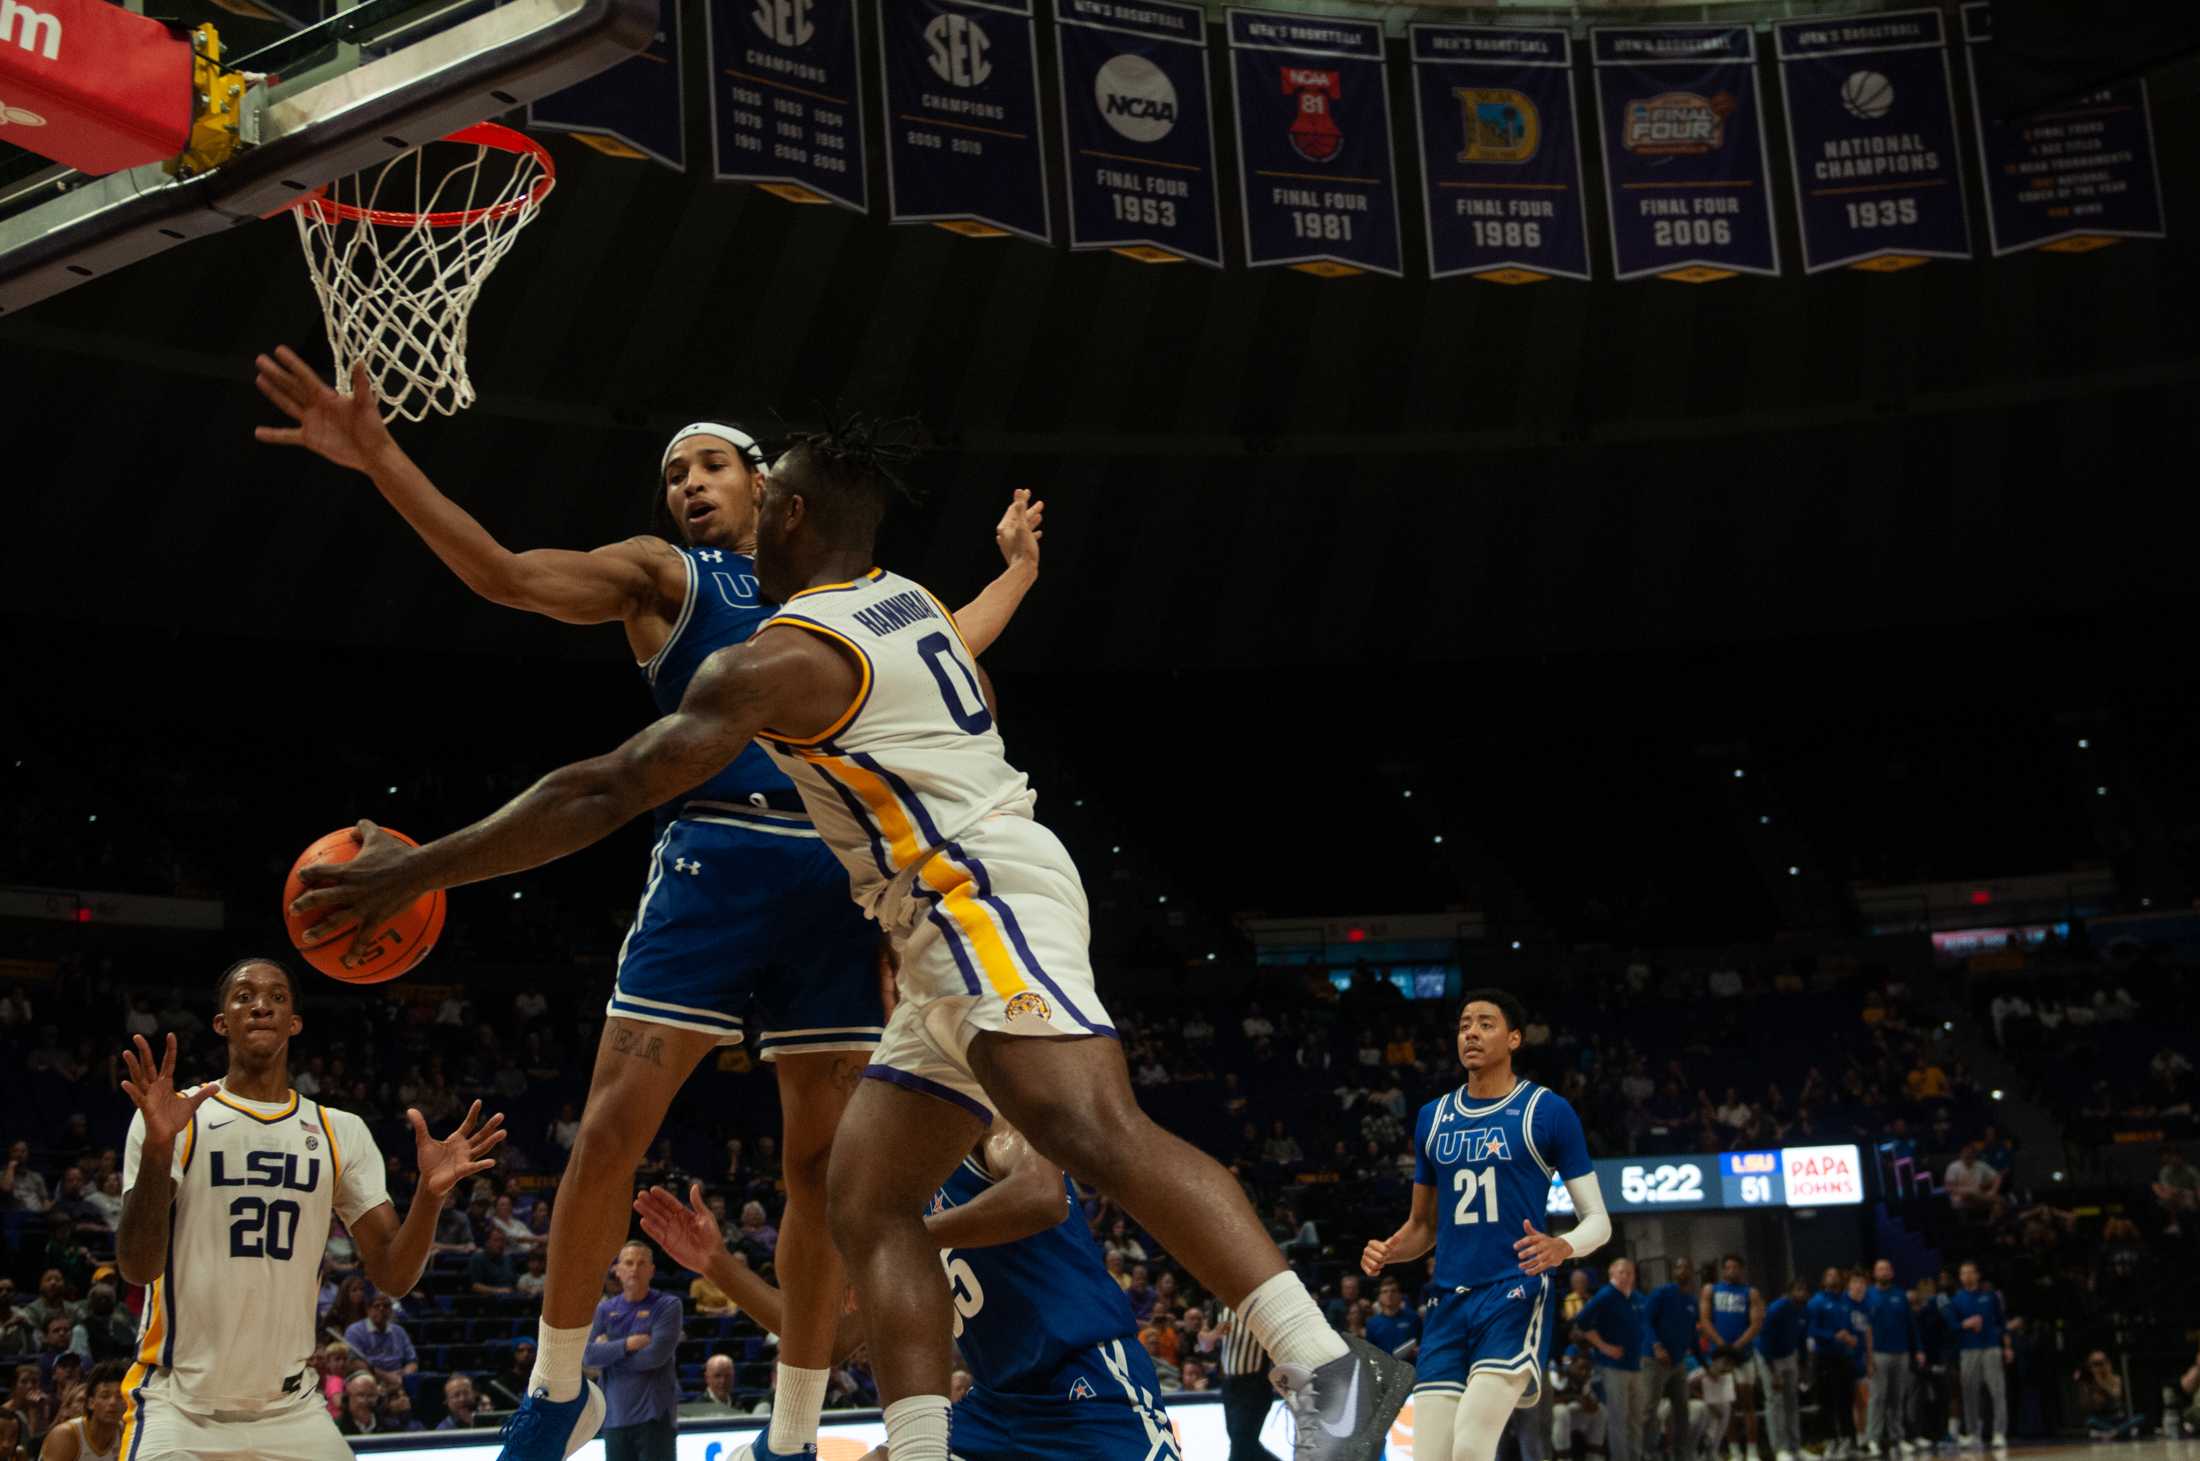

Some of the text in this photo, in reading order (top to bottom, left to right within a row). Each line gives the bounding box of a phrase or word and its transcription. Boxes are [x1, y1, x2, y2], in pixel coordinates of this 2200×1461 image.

[923, 13, 992, 88] SEC
[746, 49, 827, 84] CHAMPIONS
[1289, 69, 1331, 87] NCAA
[921, 93, 1005, 121] CHAMPIONS
[1107, 94, 1175, 124] NCAA
[1302, 95, 1325, 114] 81
[1632, 121, 1713, 140] FOUR
[1824, 133, 1926, 159] NATIONAL
[1814, 151, 1940, 180] CHAMPIONS
[1097, 169, 1190, 199] FINAL FOUR
[1112, 194, 1177, 228] 1953
[1272, 187, 1368, 211] FINAL FOUR
[1456, 199, 1554, 218] FINAL FOUR
[1640, 196, 1740, 217] FINAL FOUR
[1291, 211, 1352, 241] 1981
[1846, 198, 1919, 230] 1935
[1472, 221, 1542, 248] 1986
[1653, 218, 1732, 247] 2006
[917, 631, 992, 735] 0
[1435, 1127, 1512, 1165] UTA
[210, 1150, 320, 1192] LSU
[1731, 1154, 1775, 1174] LSU
[1791, 1157, 1849, 1177] PAPA
[1453, 1166, 1499, 1226] 21
[1621, 1164, 1704, 1202] 5:22
[1740, 1175, 1770, 1203] 51
[1793, 1182, 1853, 1195] JOHNS
[229, 1196, 300, 1260] 20
